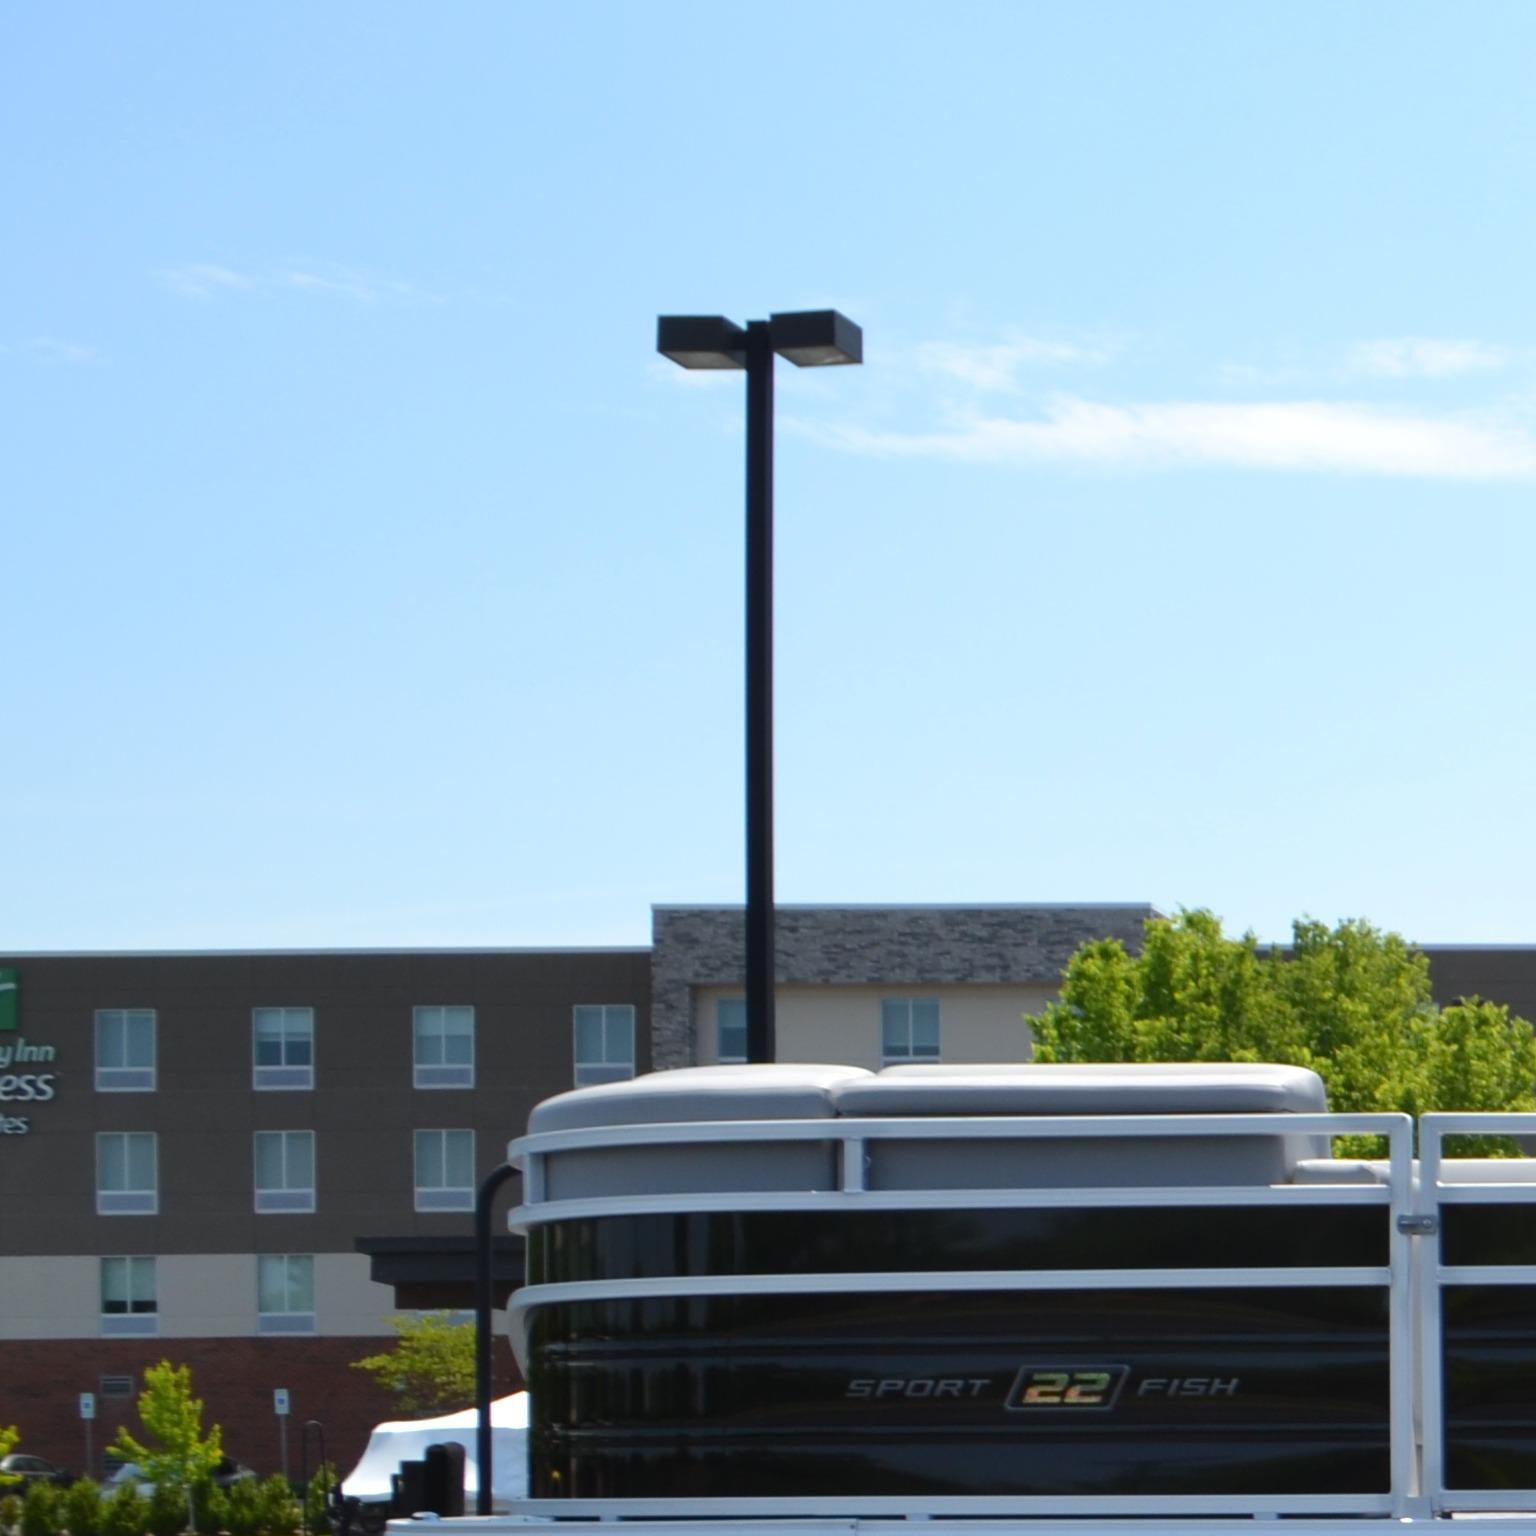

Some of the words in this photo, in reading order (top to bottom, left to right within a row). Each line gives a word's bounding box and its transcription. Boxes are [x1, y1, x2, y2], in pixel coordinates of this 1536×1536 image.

[15, 1037, 55, 1062] Inn
[845, 1378, 991, 1398] SPORT
[1021, 1372, 1111, 1404] 22
[1135, 1377, 1240, 1397] FISH
